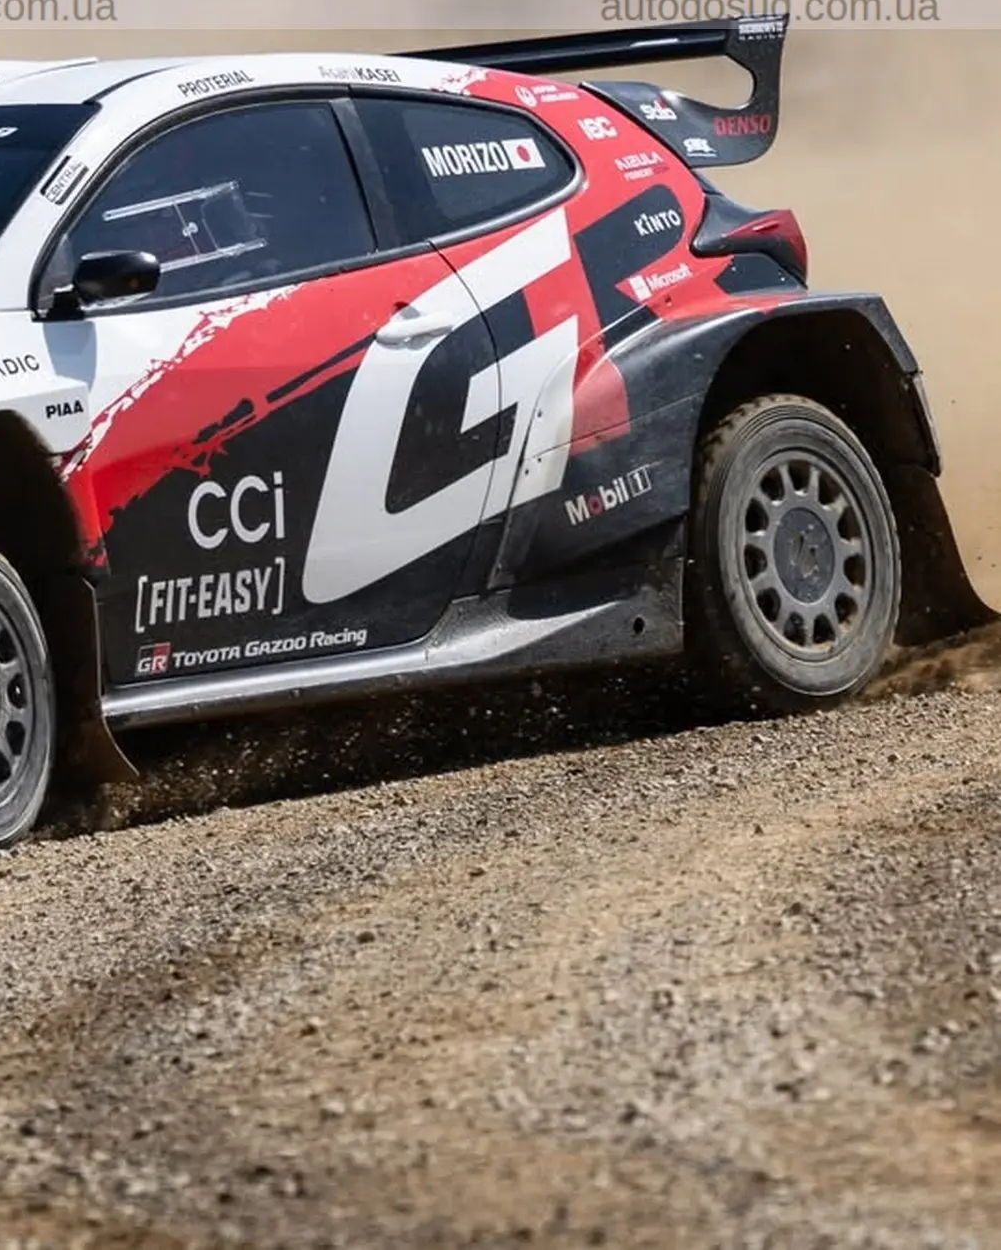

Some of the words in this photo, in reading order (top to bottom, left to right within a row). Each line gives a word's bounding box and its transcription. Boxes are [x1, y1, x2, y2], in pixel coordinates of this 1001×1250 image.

[177, 69, 254, 98] PROTERIAL
[713, 114, 771, 136] DENSO
[422, 142, 510, 177] MORIZO
[45, 160, 84, 202] CENTRAL
[45, 400, 84, 419] PIAA
[564, 476, 630, 526] Mobil
[136, 654, 168, 674] GR
[172, 644, 241, 669] TOYOTA
[244, 636, 307, 657] GAZOO
[309, 628, 368, 648] Racing
